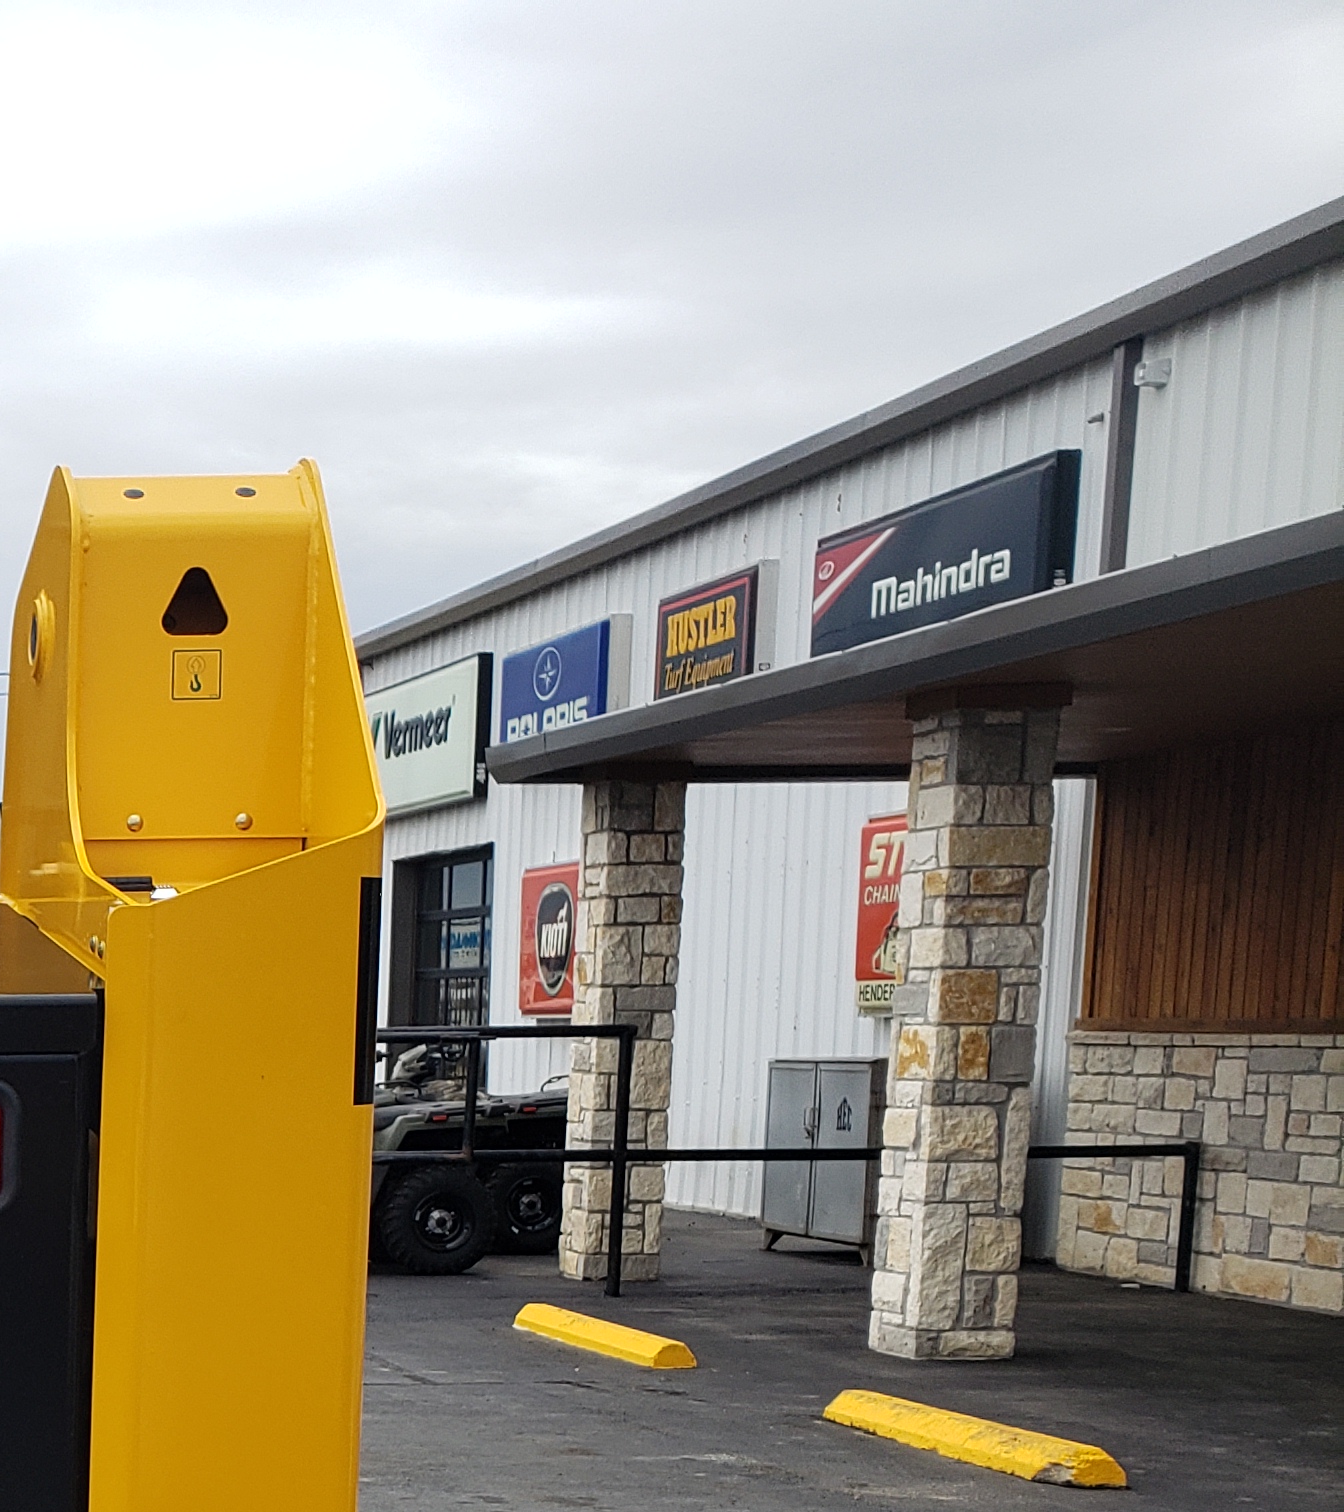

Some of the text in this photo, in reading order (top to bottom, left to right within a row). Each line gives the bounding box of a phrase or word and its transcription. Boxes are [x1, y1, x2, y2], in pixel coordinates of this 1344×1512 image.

[871, 548, 1011, 619] Mahindra
[666, 595, 737, 657] HUSTLER
[664, 649, 735, 694] Turf Equipment
[383, 704, 452, 759] Vermeer
